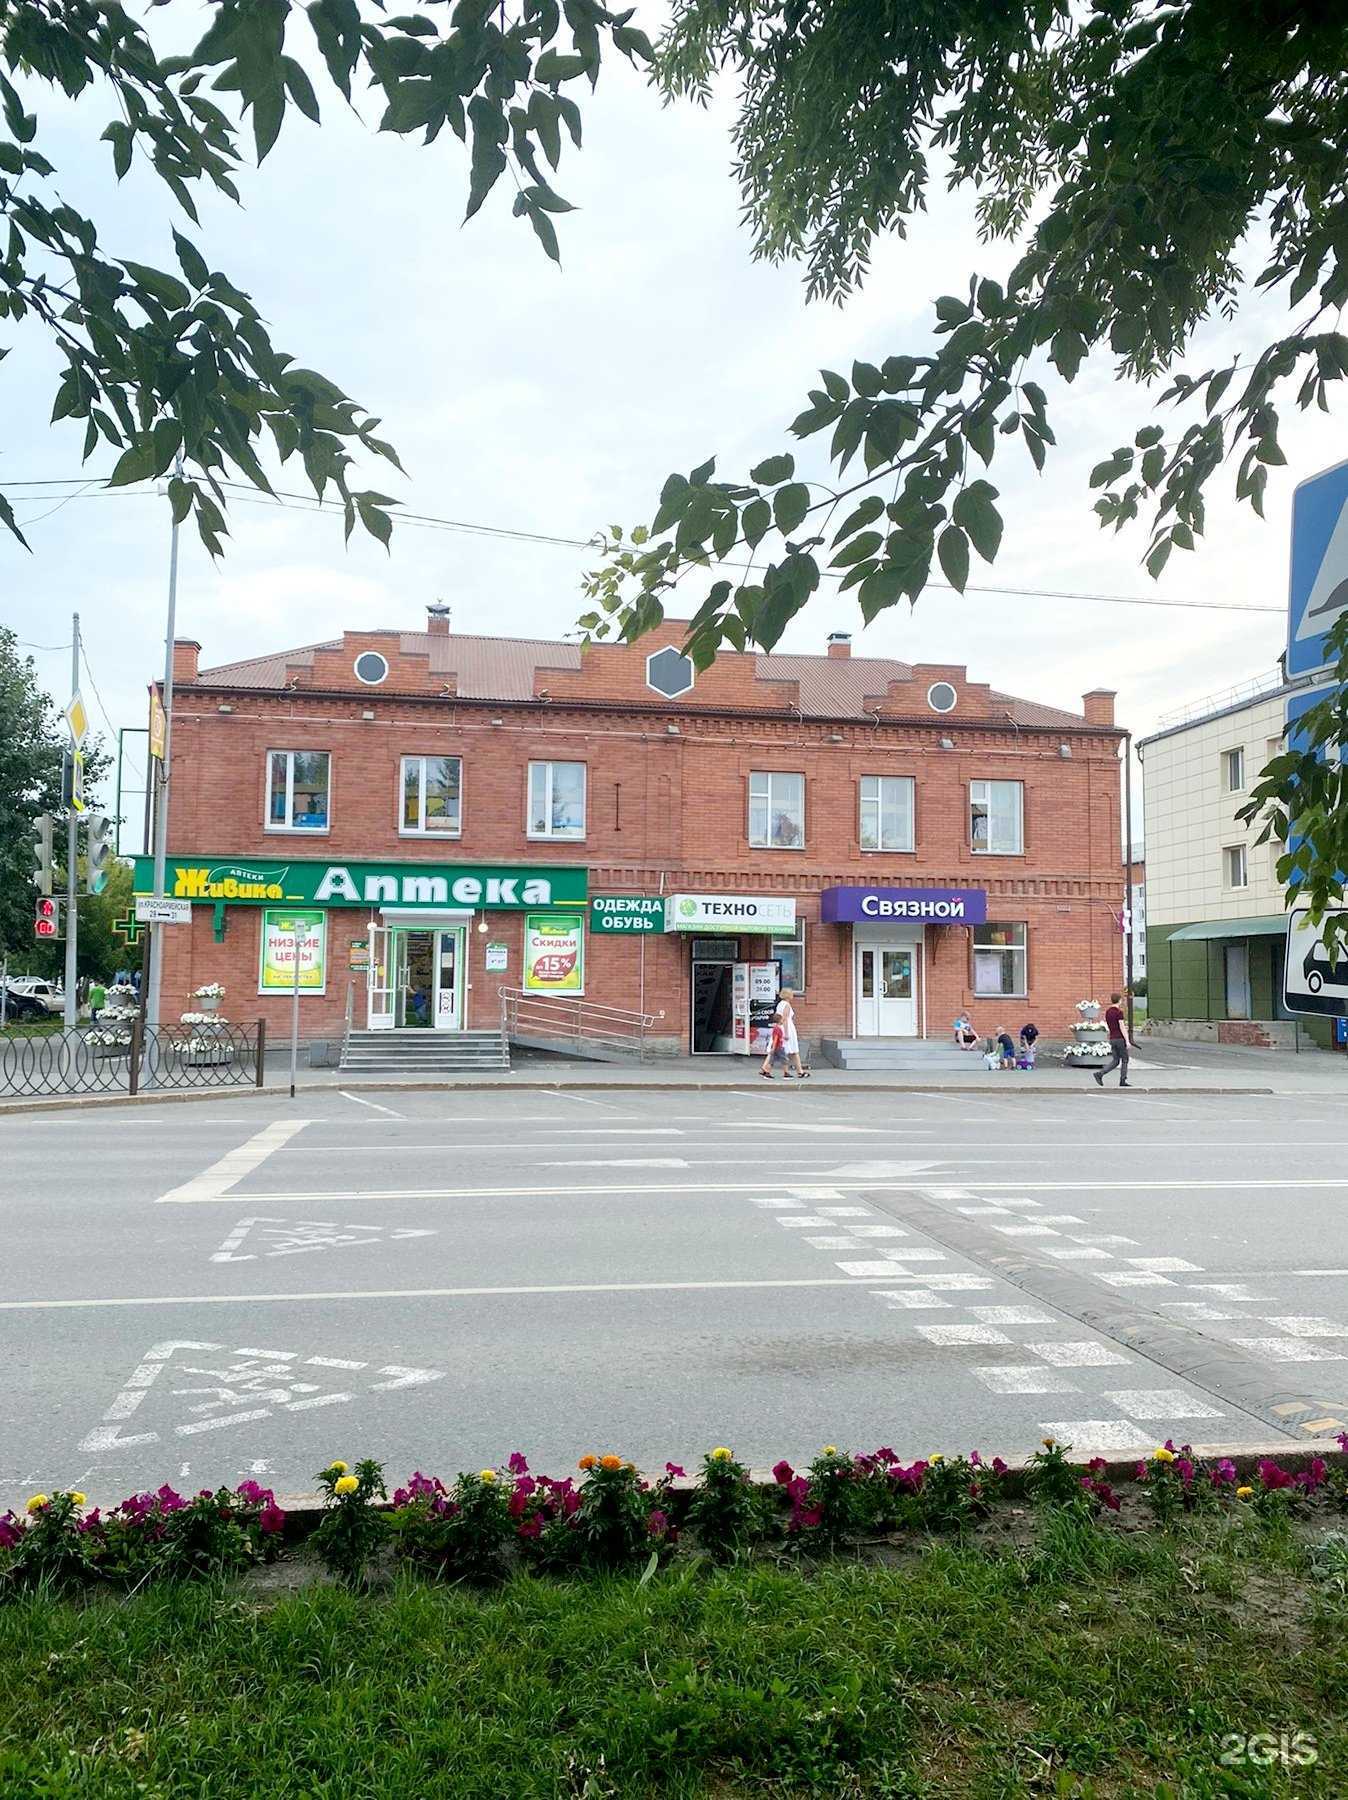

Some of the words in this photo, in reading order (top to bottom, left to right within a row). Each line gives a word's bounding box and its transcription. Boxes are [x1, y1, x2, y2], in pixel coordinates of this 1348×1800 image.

[229, 869, 265, 881] АПТЕКИ
[174, 868, 283, 899] Живика
[313, 866, 551, 905] Аптека
[593, 898, 663, 915] ОДЕЖДА
[601, 916, 654, 930] ОБУВЬ
[531, 937, 577, 949] Скидки
